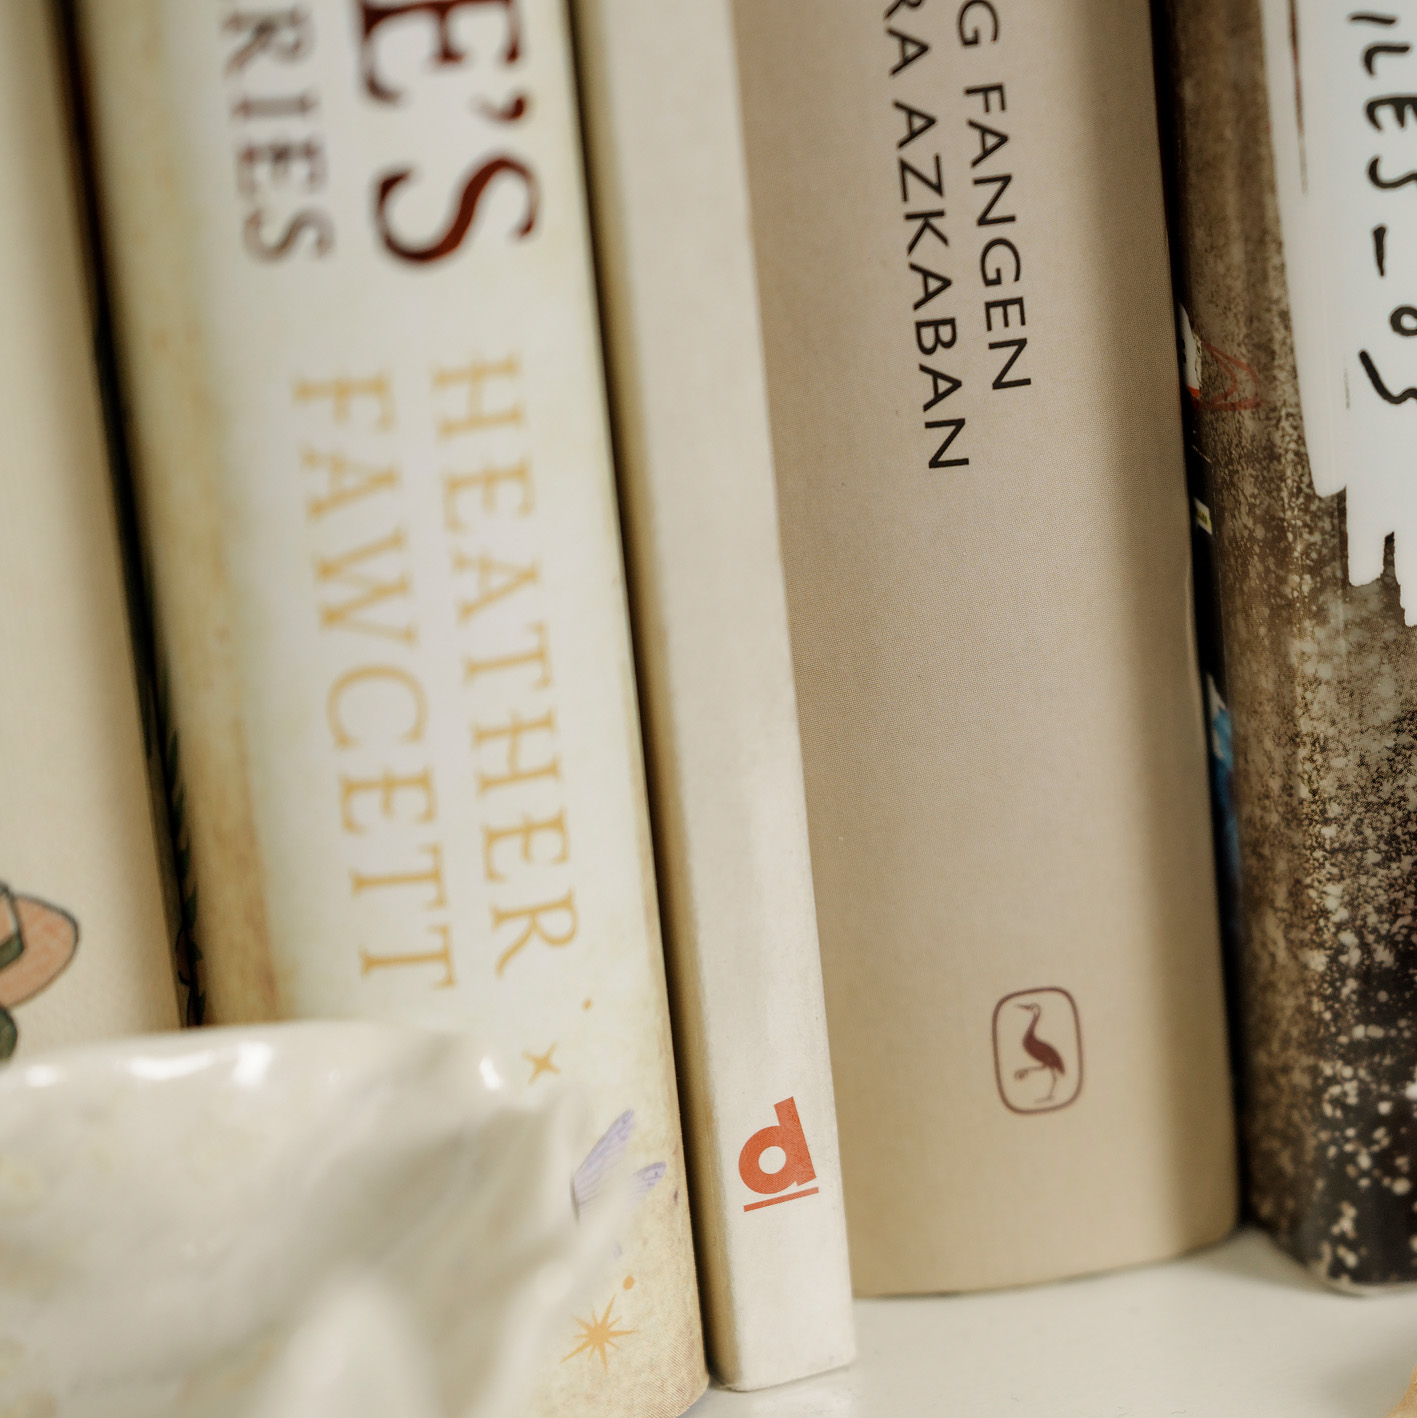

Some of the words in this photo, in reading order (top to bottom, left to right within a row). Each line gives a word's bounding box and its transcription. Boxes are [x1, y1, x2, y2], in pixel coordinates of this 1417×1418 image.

[893, 99, 970, 470] AZKABAN
[964, 82, 1031, 392] FANGEN
[293, 373, 457, 988] FAWCETT
[432, 356, 580, 977] HEATHER
